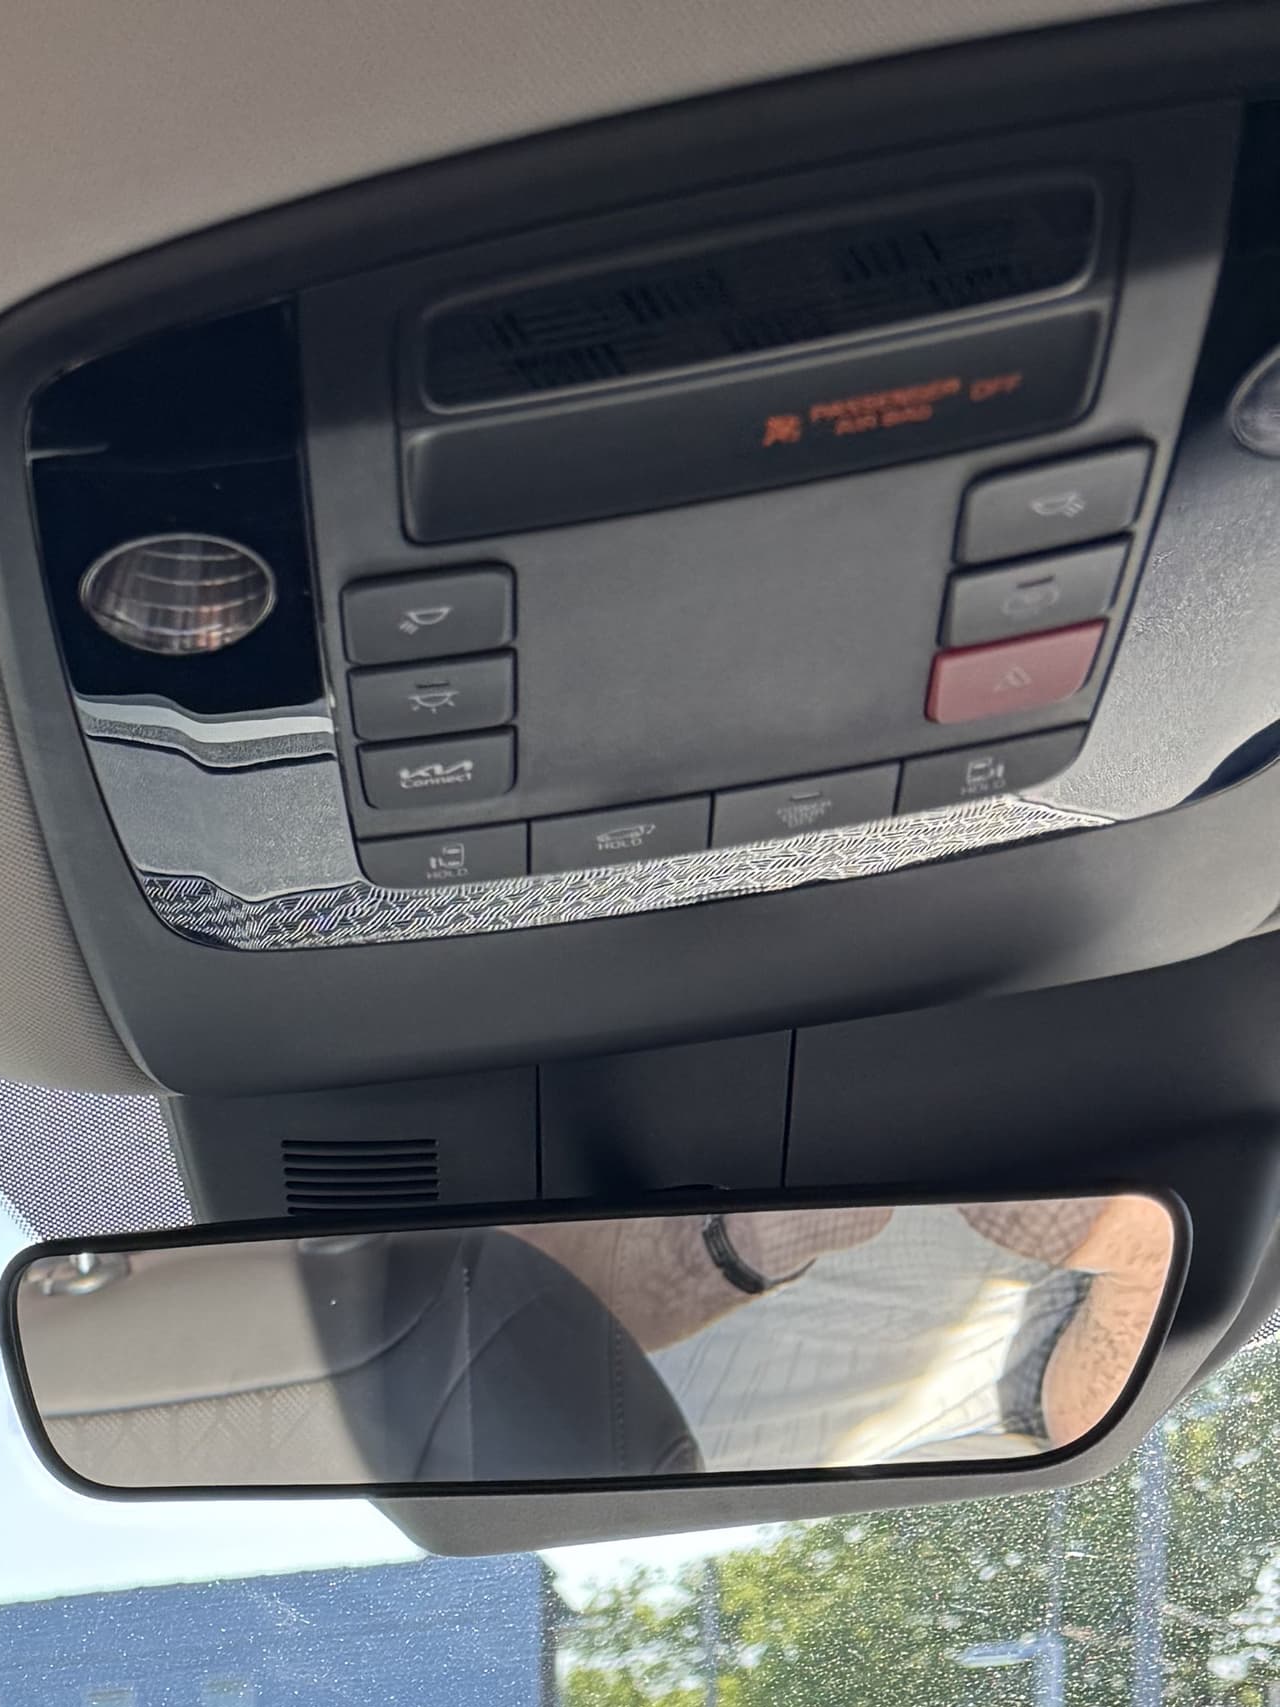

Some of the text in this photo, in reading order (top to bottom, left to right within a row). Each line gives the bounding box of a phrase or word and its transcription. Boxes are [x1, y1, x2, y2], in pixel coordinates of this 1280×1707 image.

[400, 773, 472, 789] Connect
[597, 837, 643, 850] HOLD
[426, 867, 469, 880] HOLD
